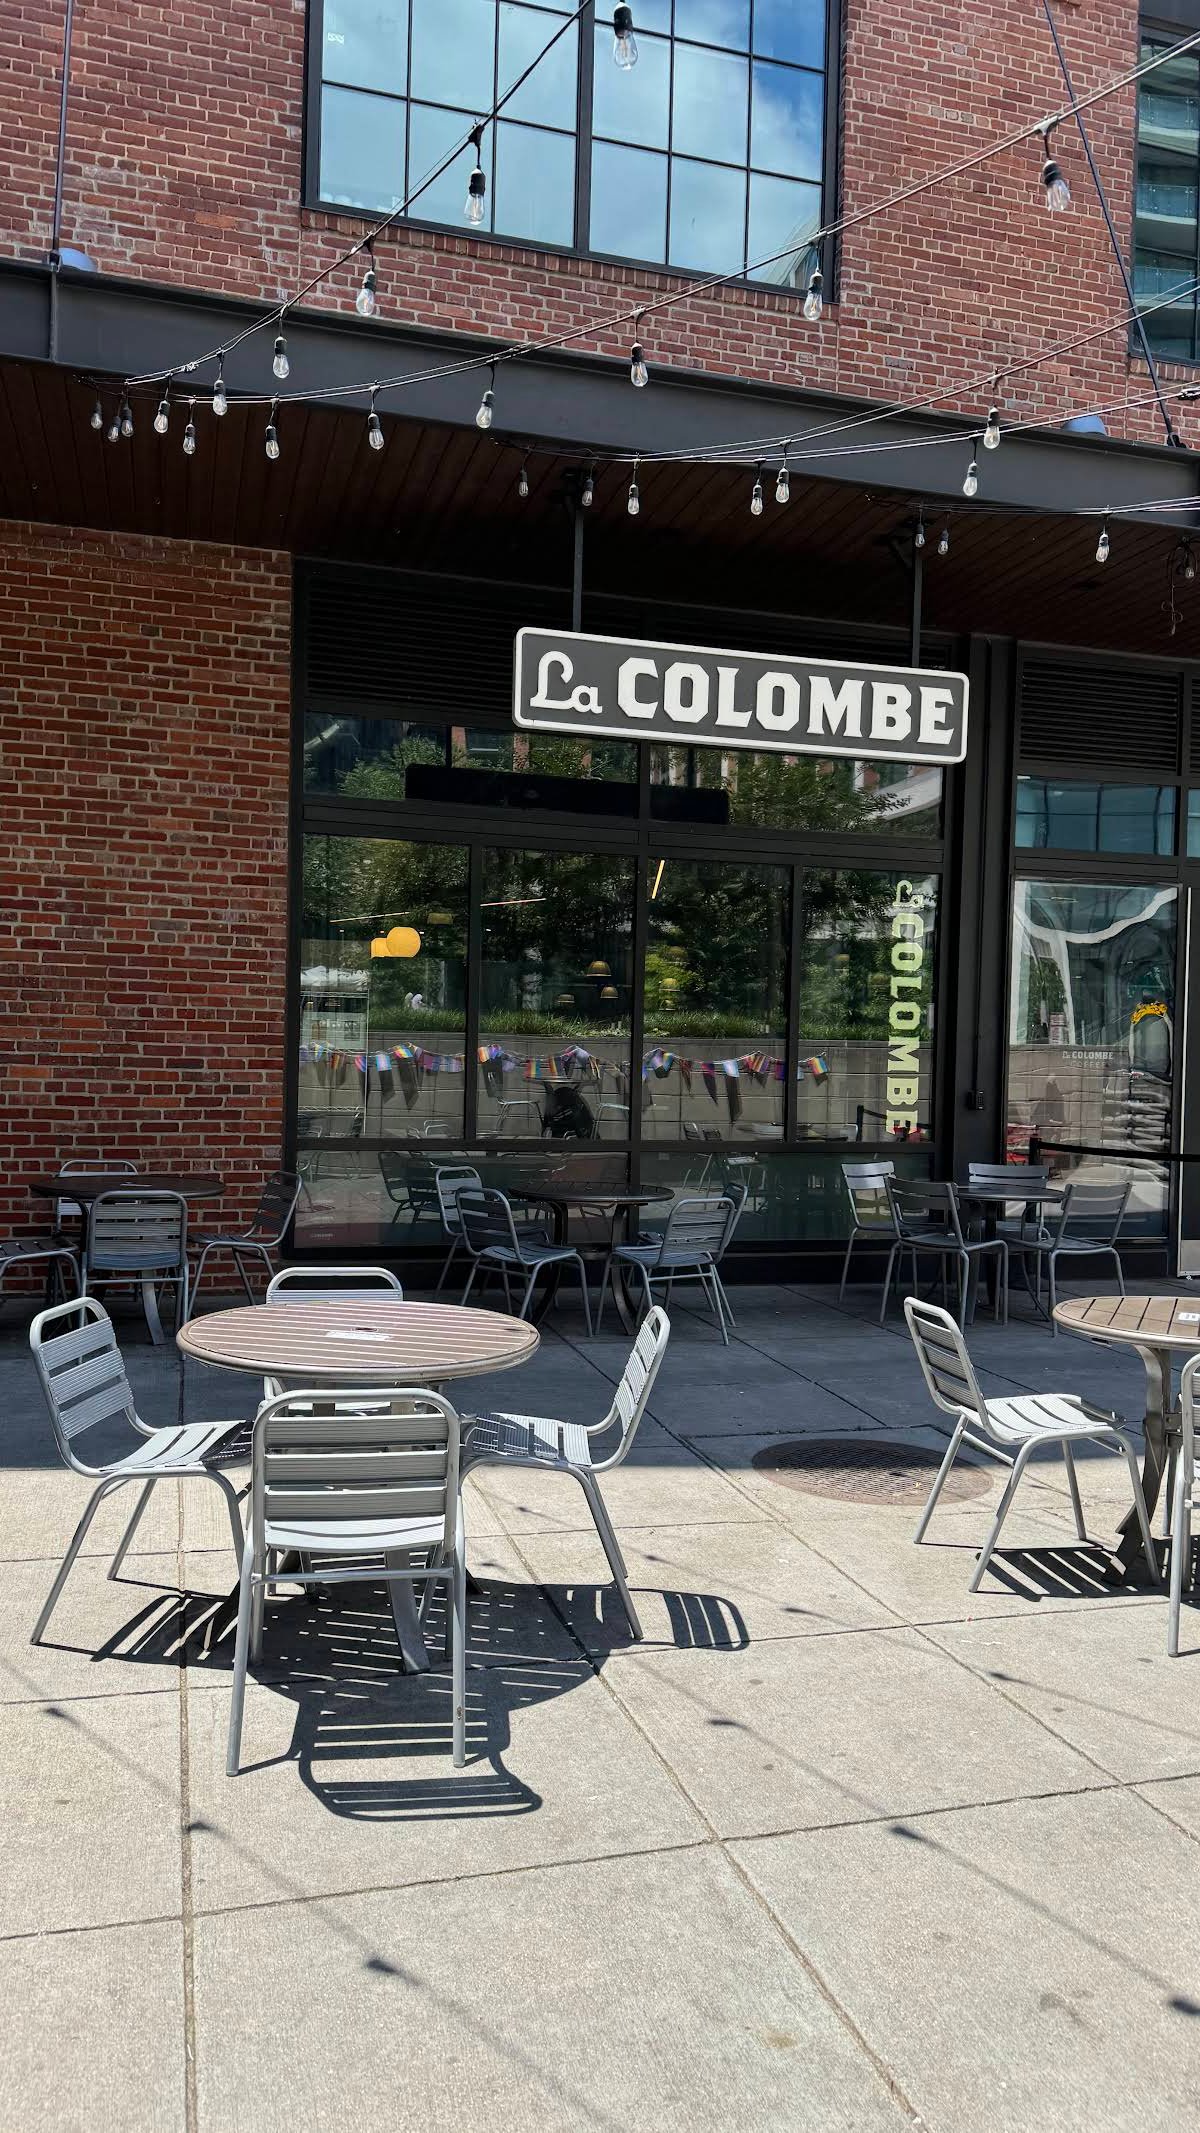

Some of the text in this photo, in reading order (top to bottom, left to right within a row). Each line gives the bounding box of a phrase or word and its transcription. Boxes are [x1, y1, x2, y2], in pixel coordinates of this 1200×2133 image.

[530, 651, 955, 745] La COLOMBE
[886, 913, 924, 1135] COLOMBE
[1072, 1051, 1114, 1060] COLOMBE
